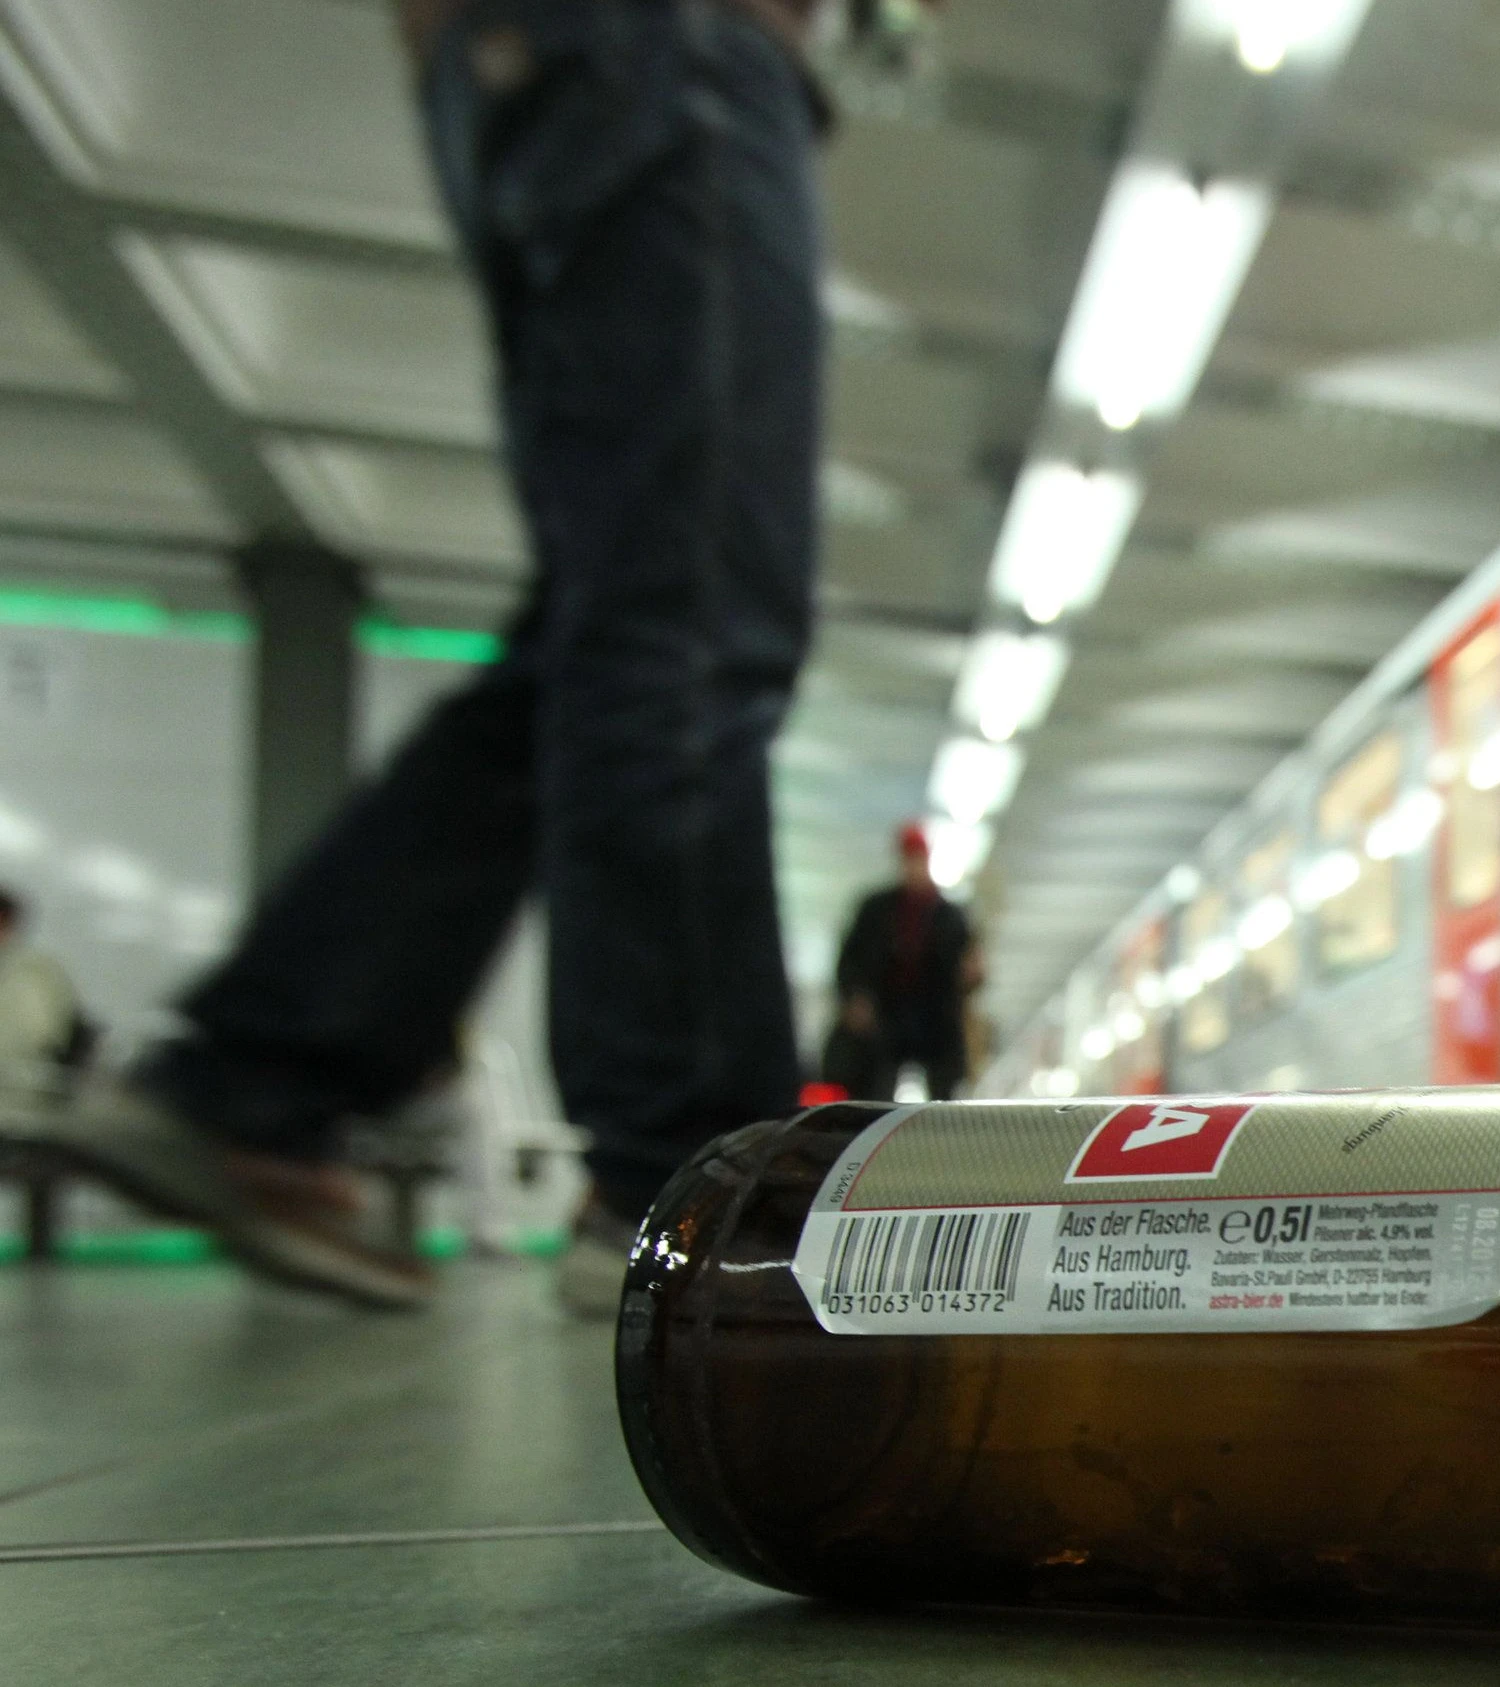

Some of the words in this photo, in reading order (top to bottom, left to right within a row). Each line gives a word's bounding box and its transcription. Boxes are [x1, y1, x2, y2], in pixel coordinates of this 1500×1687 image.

[1059, 1211, 1096, 1238] Aus
[1101, 1209, 1133, 1236] der
[1135, 1208, 1212, 1236] Flasche.
[1052, 1246, 1091, 1274] Aus
[1096, 1245, 1192, 1277] Hamburg.
[828, 1294, 910, 1314] 031063
[920, 1292, 1006, 1312] 014372
[1047, 1283, 1086, 1312] Aus
[1093, 1281, 1187, 1311] Tradition.
